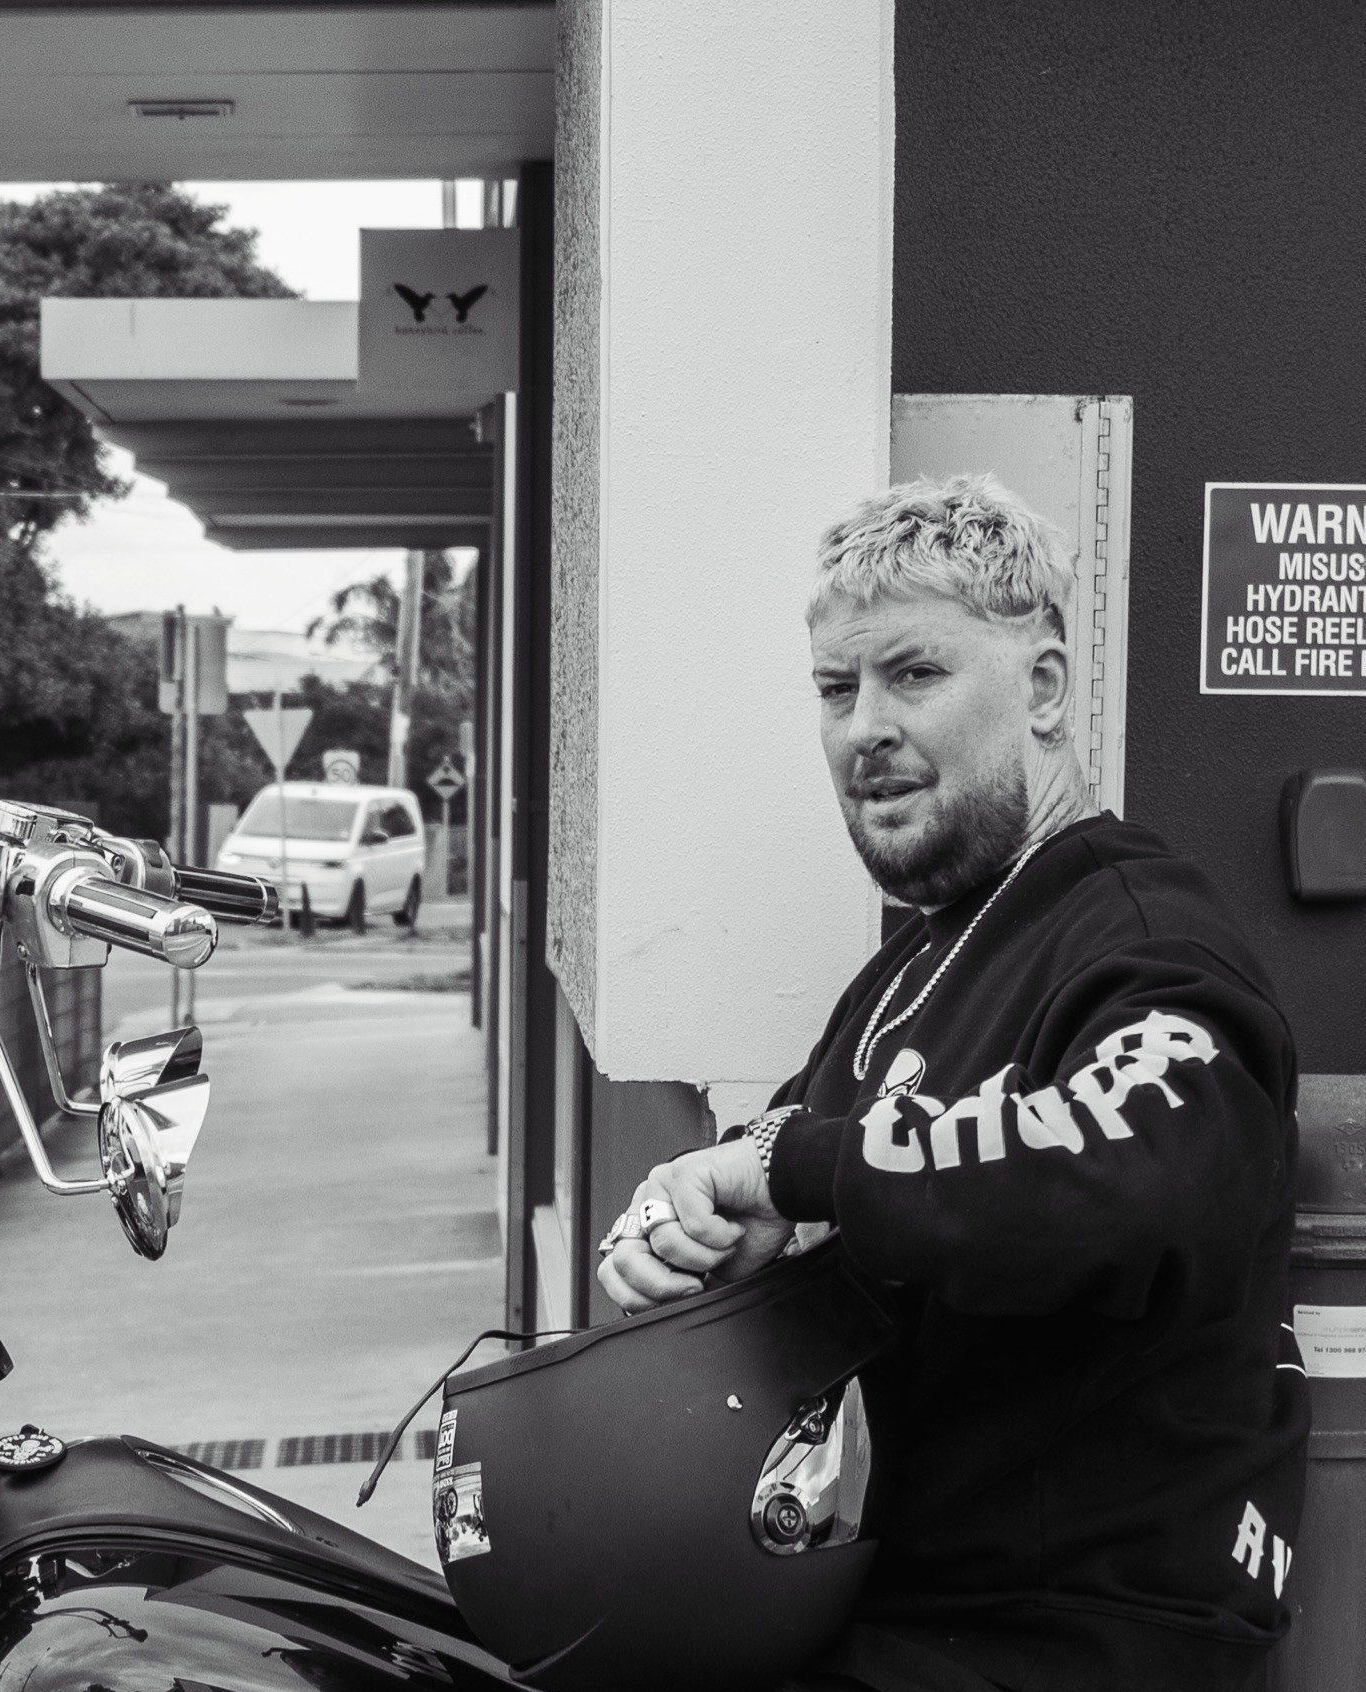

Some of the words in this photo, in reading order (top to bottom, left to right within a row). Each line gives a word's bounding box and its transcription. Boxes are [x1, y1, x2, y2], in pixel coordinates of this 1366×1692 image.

[1226, 615, 1298, 644] HOSE
[1221, 647, 1286, 676] CALL
[1295, 649, 1353, 677] FIRE
